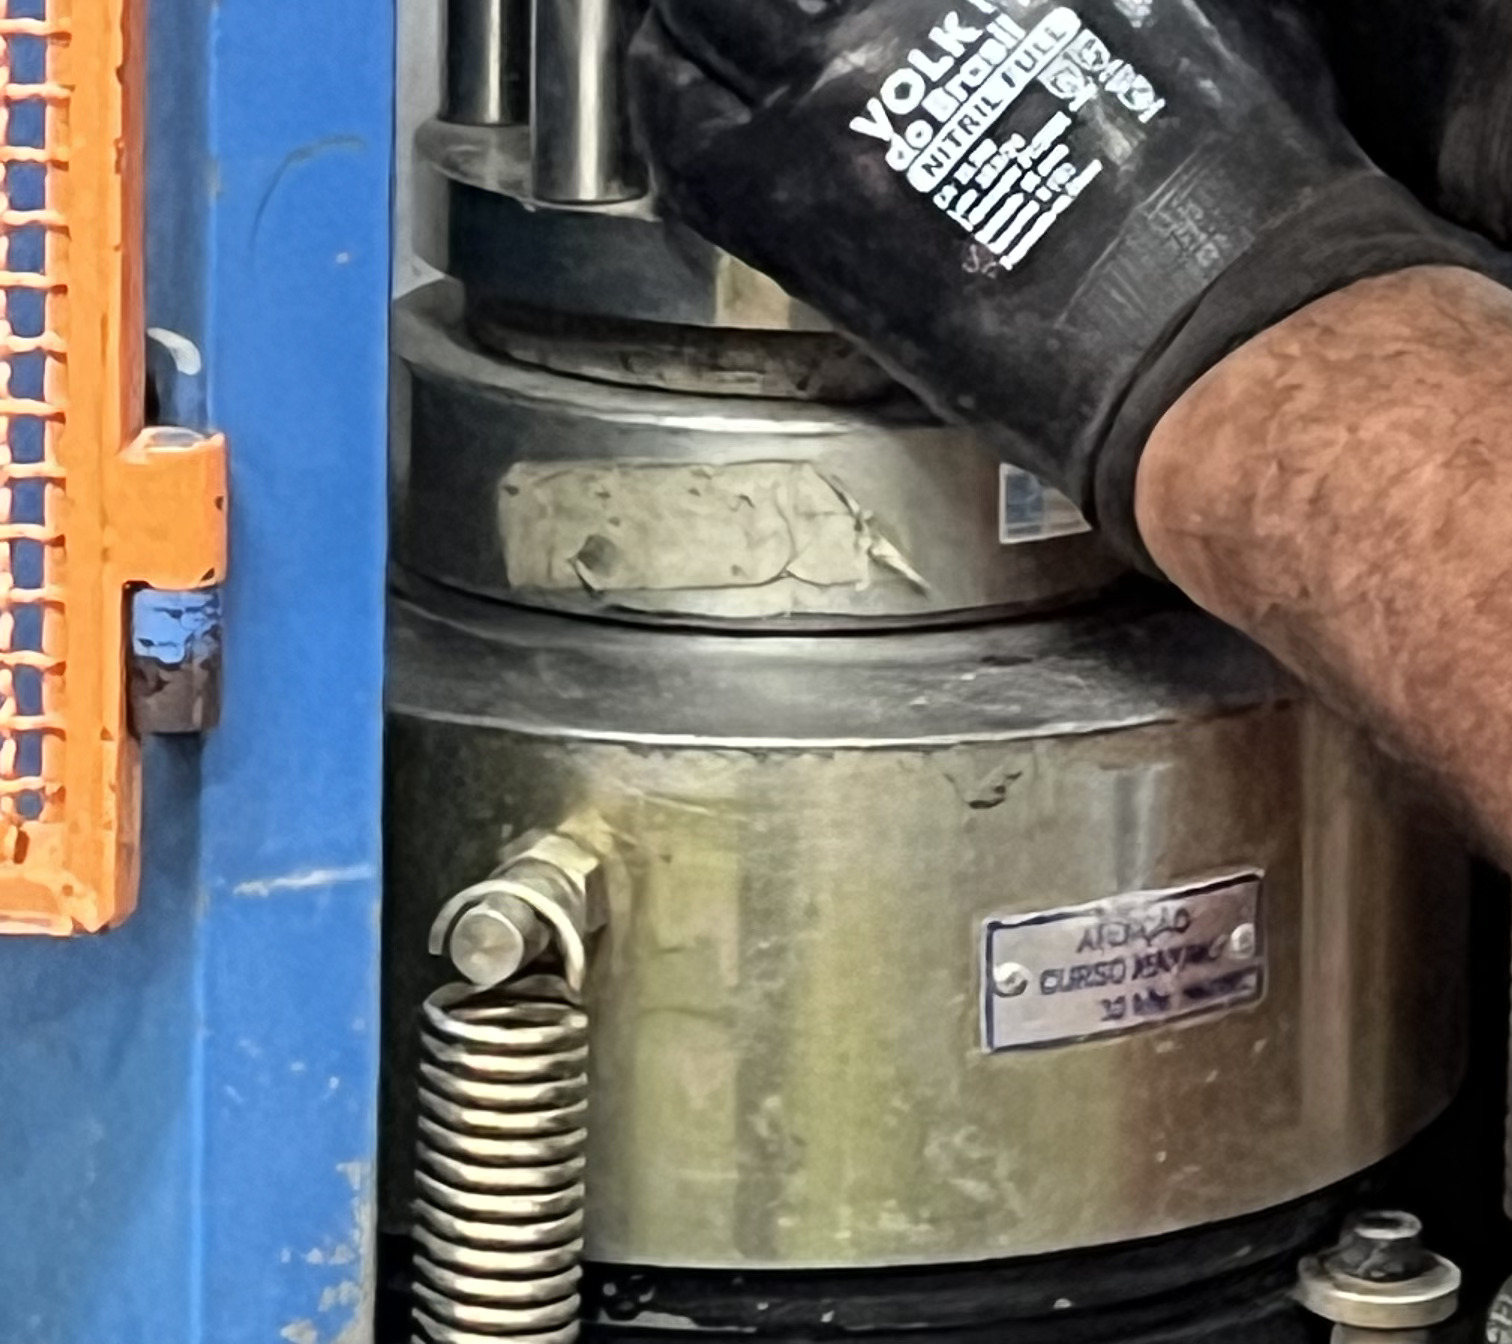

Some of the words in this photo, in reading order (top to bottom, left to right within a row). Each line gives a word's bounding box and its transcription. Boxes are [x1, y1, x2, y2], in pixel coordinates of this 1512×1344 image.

[850, 11, 983, 143] VOLK
[885, 120, 933, 172] do
[922, 12, 1026, 122] Brasil
[921, 91, 1003, 178] NITRIL
[1040, 961, 1127, 996] CURSO
